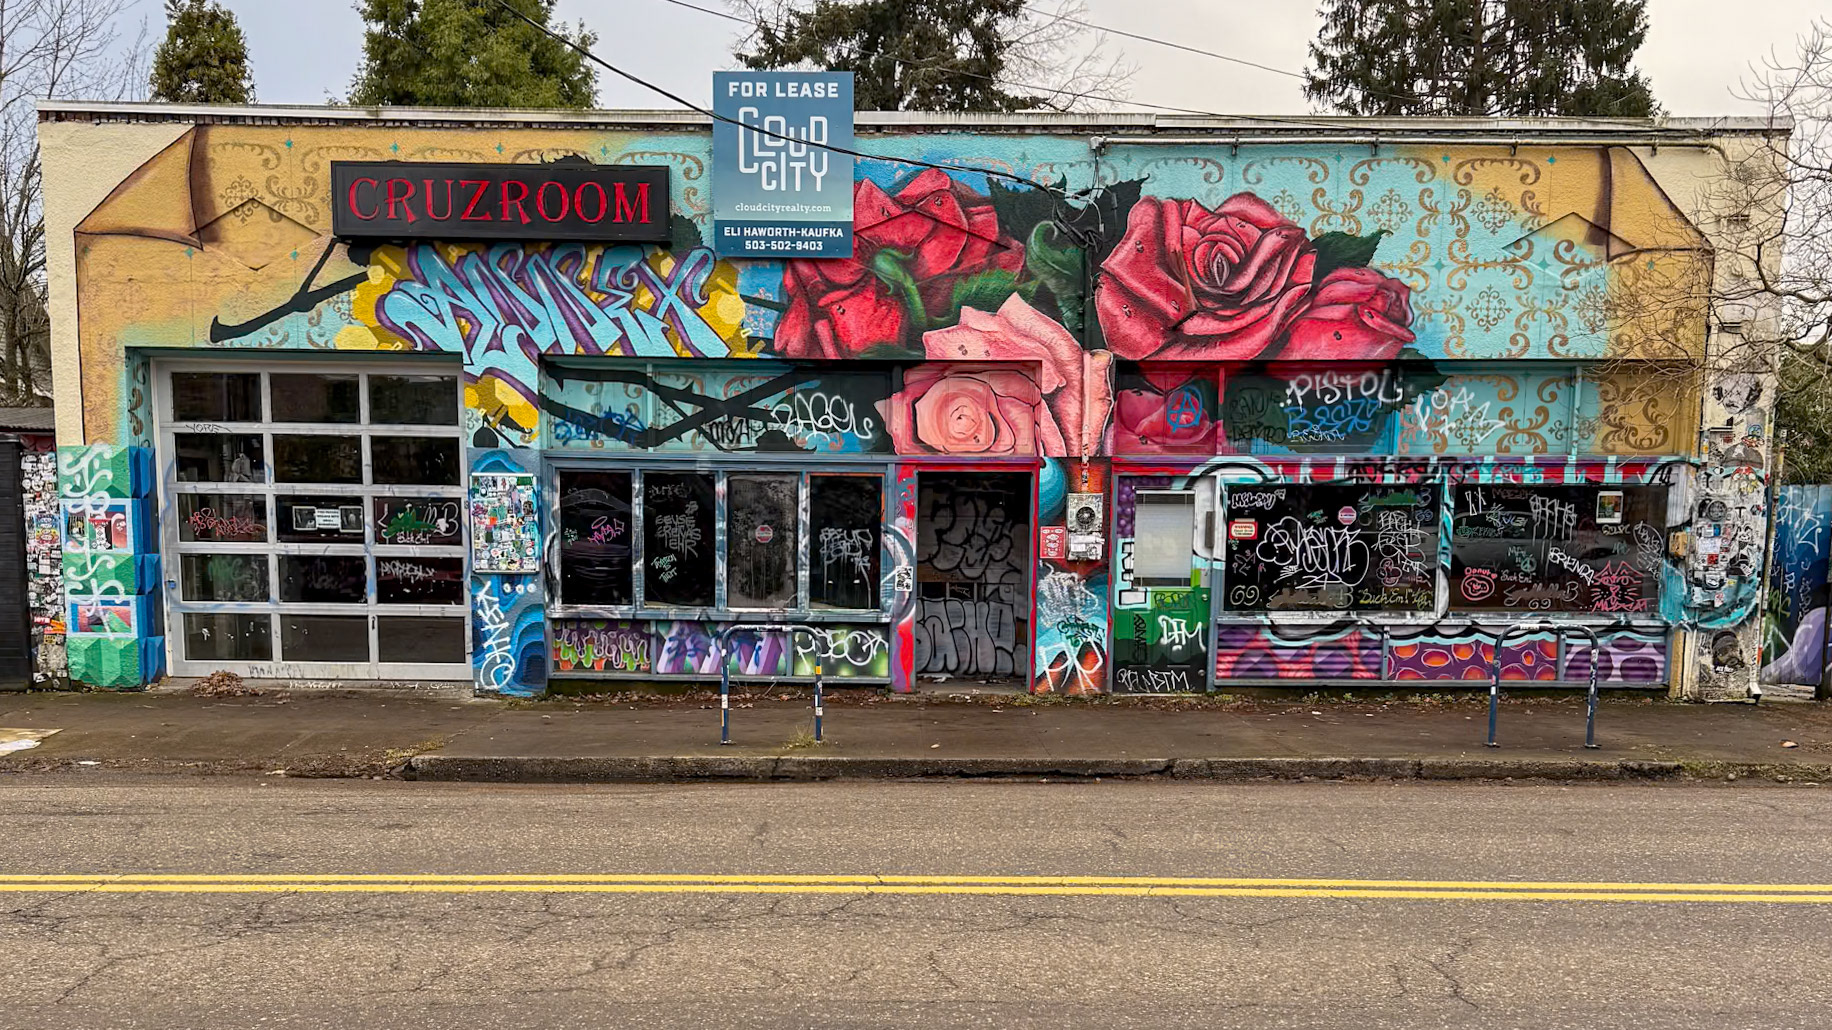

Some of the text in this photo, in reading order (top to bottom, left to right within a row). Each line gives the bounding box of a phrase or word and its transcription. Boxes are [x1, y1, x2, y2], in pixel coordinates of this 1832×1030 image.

[728, 82, 838, 98] FOR LEASE
[738, 106, 828, 173] CLOUD
[761, 151, 828, 192] CITY
[348, 177, 652, 226] CRUZROOM
[735, 202, 832, 214] cloudcityrealty.com
[724, 226, 843, 238] ELI HAWORTH-KAUFKA
[745, 240, 823, 251] 503-502-9403
